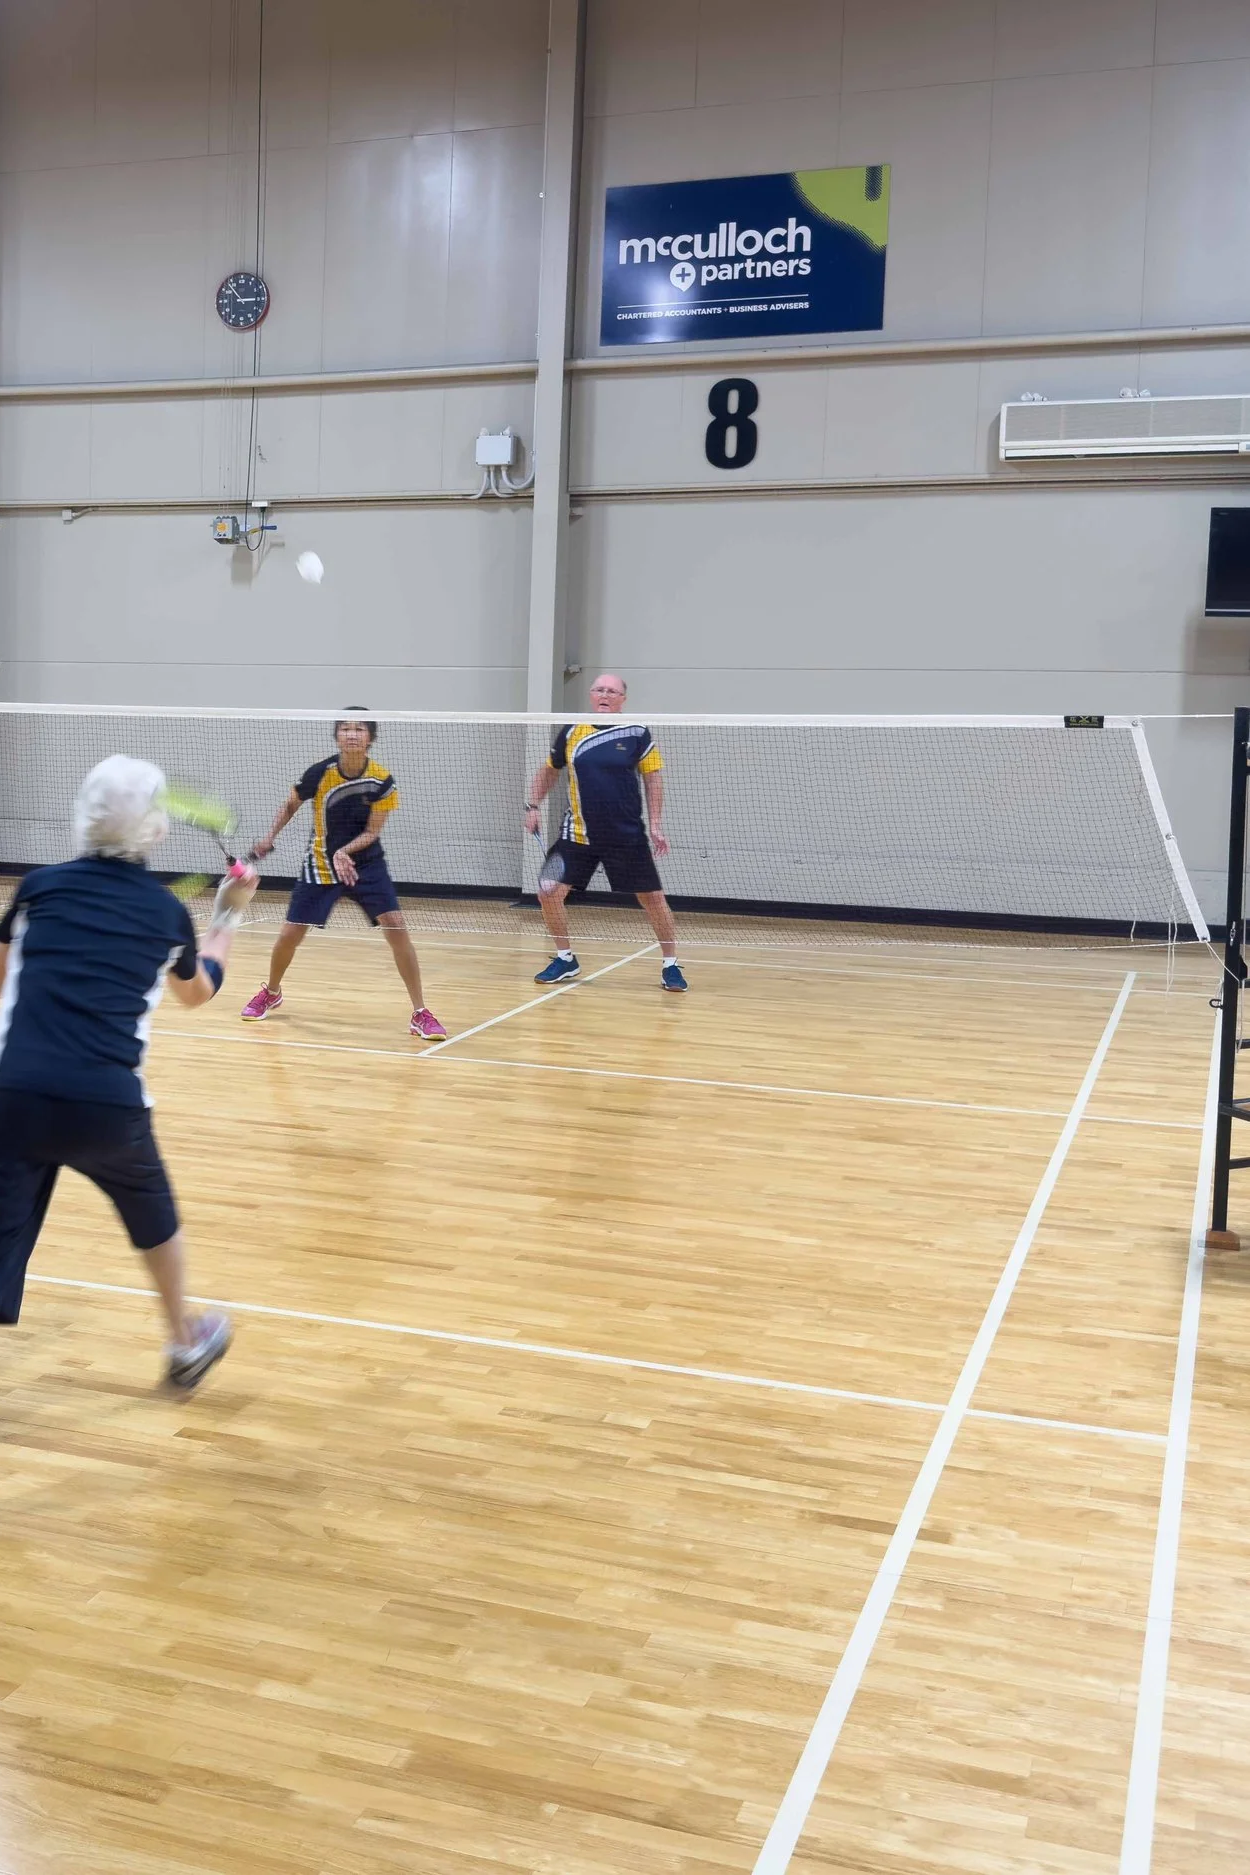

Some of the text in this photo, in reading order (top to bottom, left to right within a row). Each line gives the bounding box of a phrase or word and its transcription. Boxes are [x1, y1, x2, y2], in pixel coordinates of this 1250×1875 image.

[701, 257, 811, 286] partners
[617, 311, 663, 320] CHARTERED
[665, 307, 722, 317] ACCOUNTANTS
[729, 304, 768, 313] BUSINESS
[770, 302, 809, 311] ADVISERS
[705, 378, 758, 469] 8
